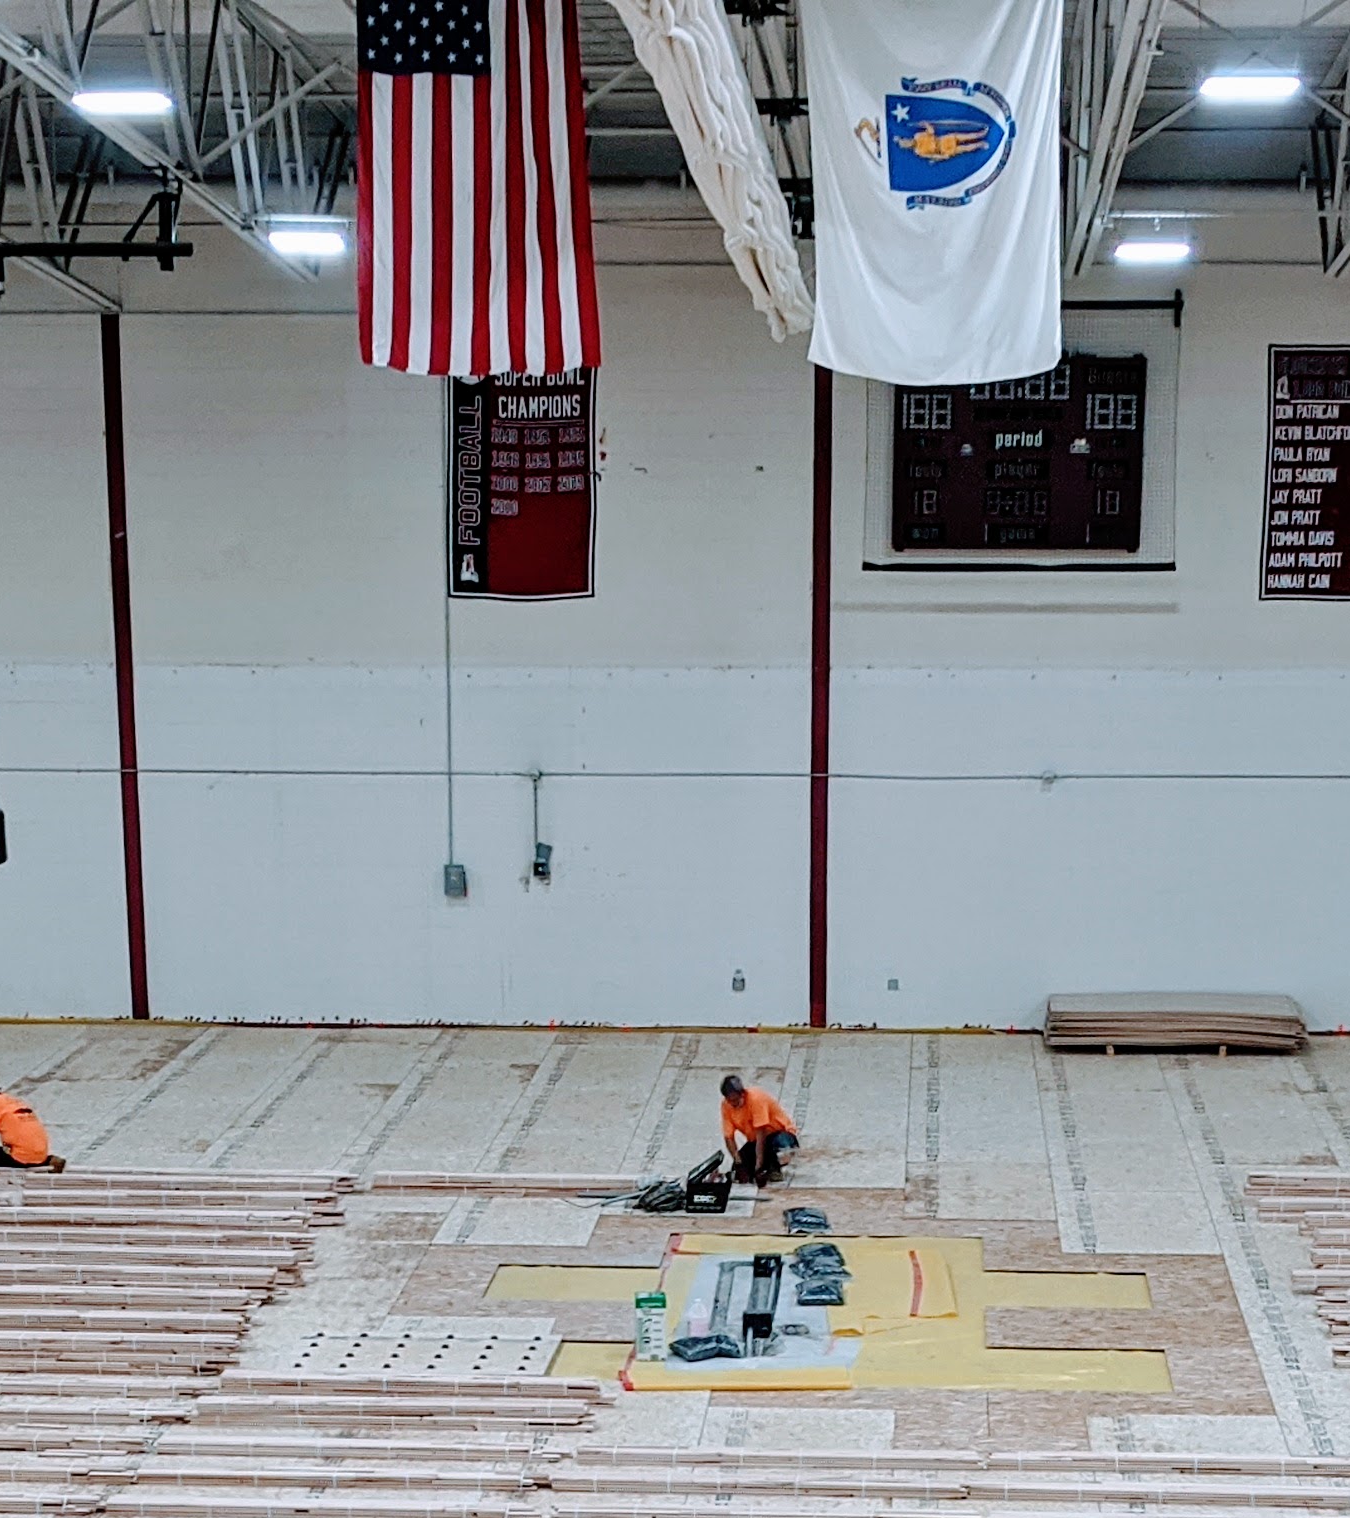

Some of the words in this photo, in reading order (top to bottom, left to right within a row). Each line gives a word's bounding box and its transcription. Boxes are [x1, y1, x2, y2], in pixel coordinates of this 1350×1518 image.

[498, 394, 581, 419] CHAMPIONS
[1275, 405, 1293, 419] DON
[995, 429, 1043, 449] period
[1275, 426, 1302, 440] KEVIN
[1273, 447, 1302, 462] PAULA
[1306, 447, 1331, 462] RYAN
[458, 395, 482, 545] FOOTBALL
[1272, 468, 1292, 483] LORI
[1271, 489, 1289, 504] JAY
[1292, 489, 1322, 504] PRATT
[1291, 510, 1321, 525] PRATT
[1308, 531, 1334, 546] DAVIS
[1268, 552, 1295, 567] ADAM
[1298, 552, 1343, 567] PHILPOTT
[1267, 574, 1304, 589] HANNAH
[1308, 574, 1330, 589] CAIN
